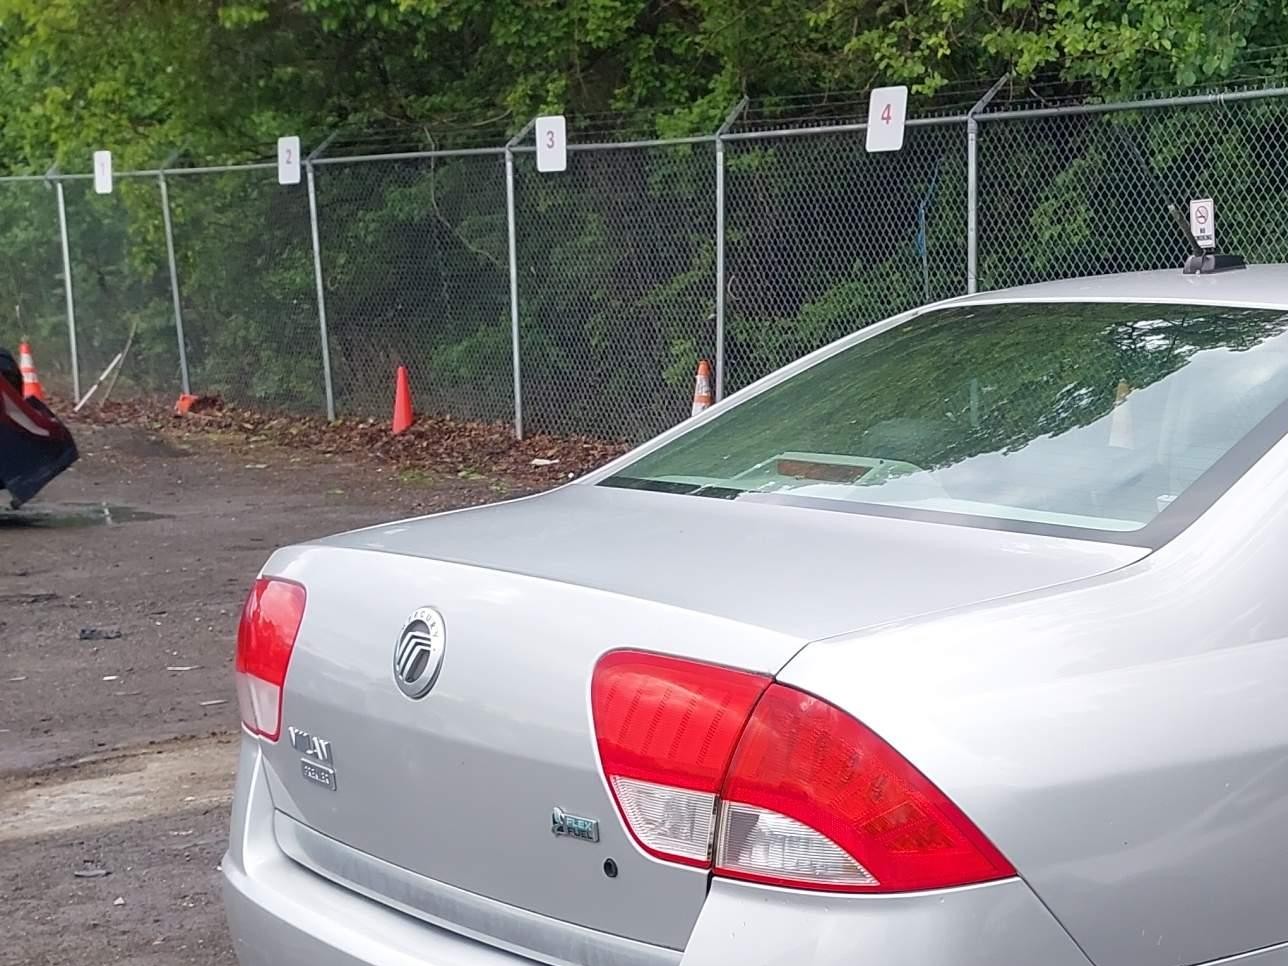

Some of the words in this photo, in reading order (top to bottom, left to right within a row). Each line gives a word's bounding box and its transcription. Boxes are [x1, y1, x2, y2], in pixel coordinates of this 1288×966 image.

[881, 103, 892, 125] 4
[546, 130, 555, 149] 3
[285, 149, 292, 165] 2
[566, 817, 593, 831] FLEX
